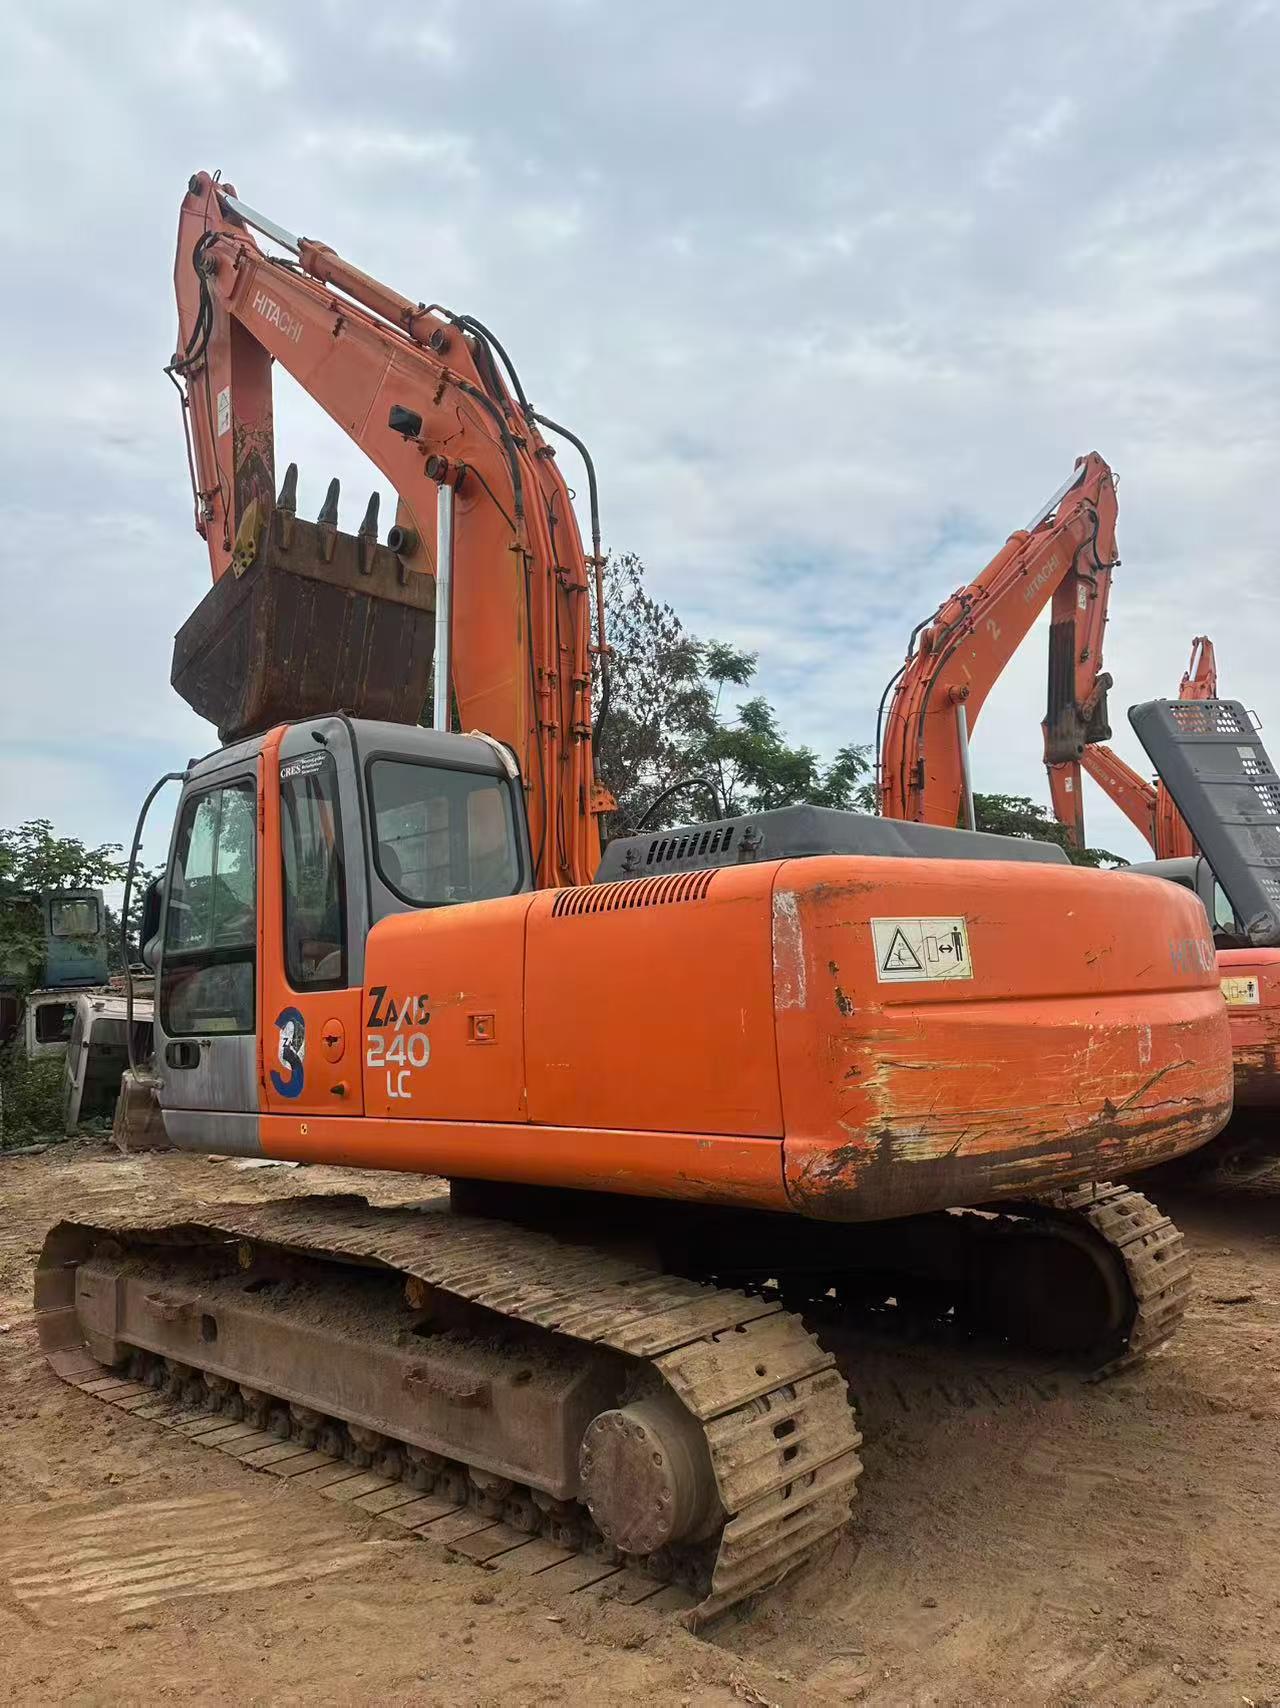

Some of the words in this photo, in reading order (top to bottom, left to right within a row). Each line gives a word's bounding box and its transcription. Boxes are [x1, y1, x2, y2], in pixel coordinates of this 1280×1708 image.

[252, 290, 304, 343] HITACHI
[1023, 553, 1061, 605] HITACHI
[280, 765, 301, 778] CRES
[367, 1032, 430, 1068] 240
[386, 1070, 412, 1098] LC
